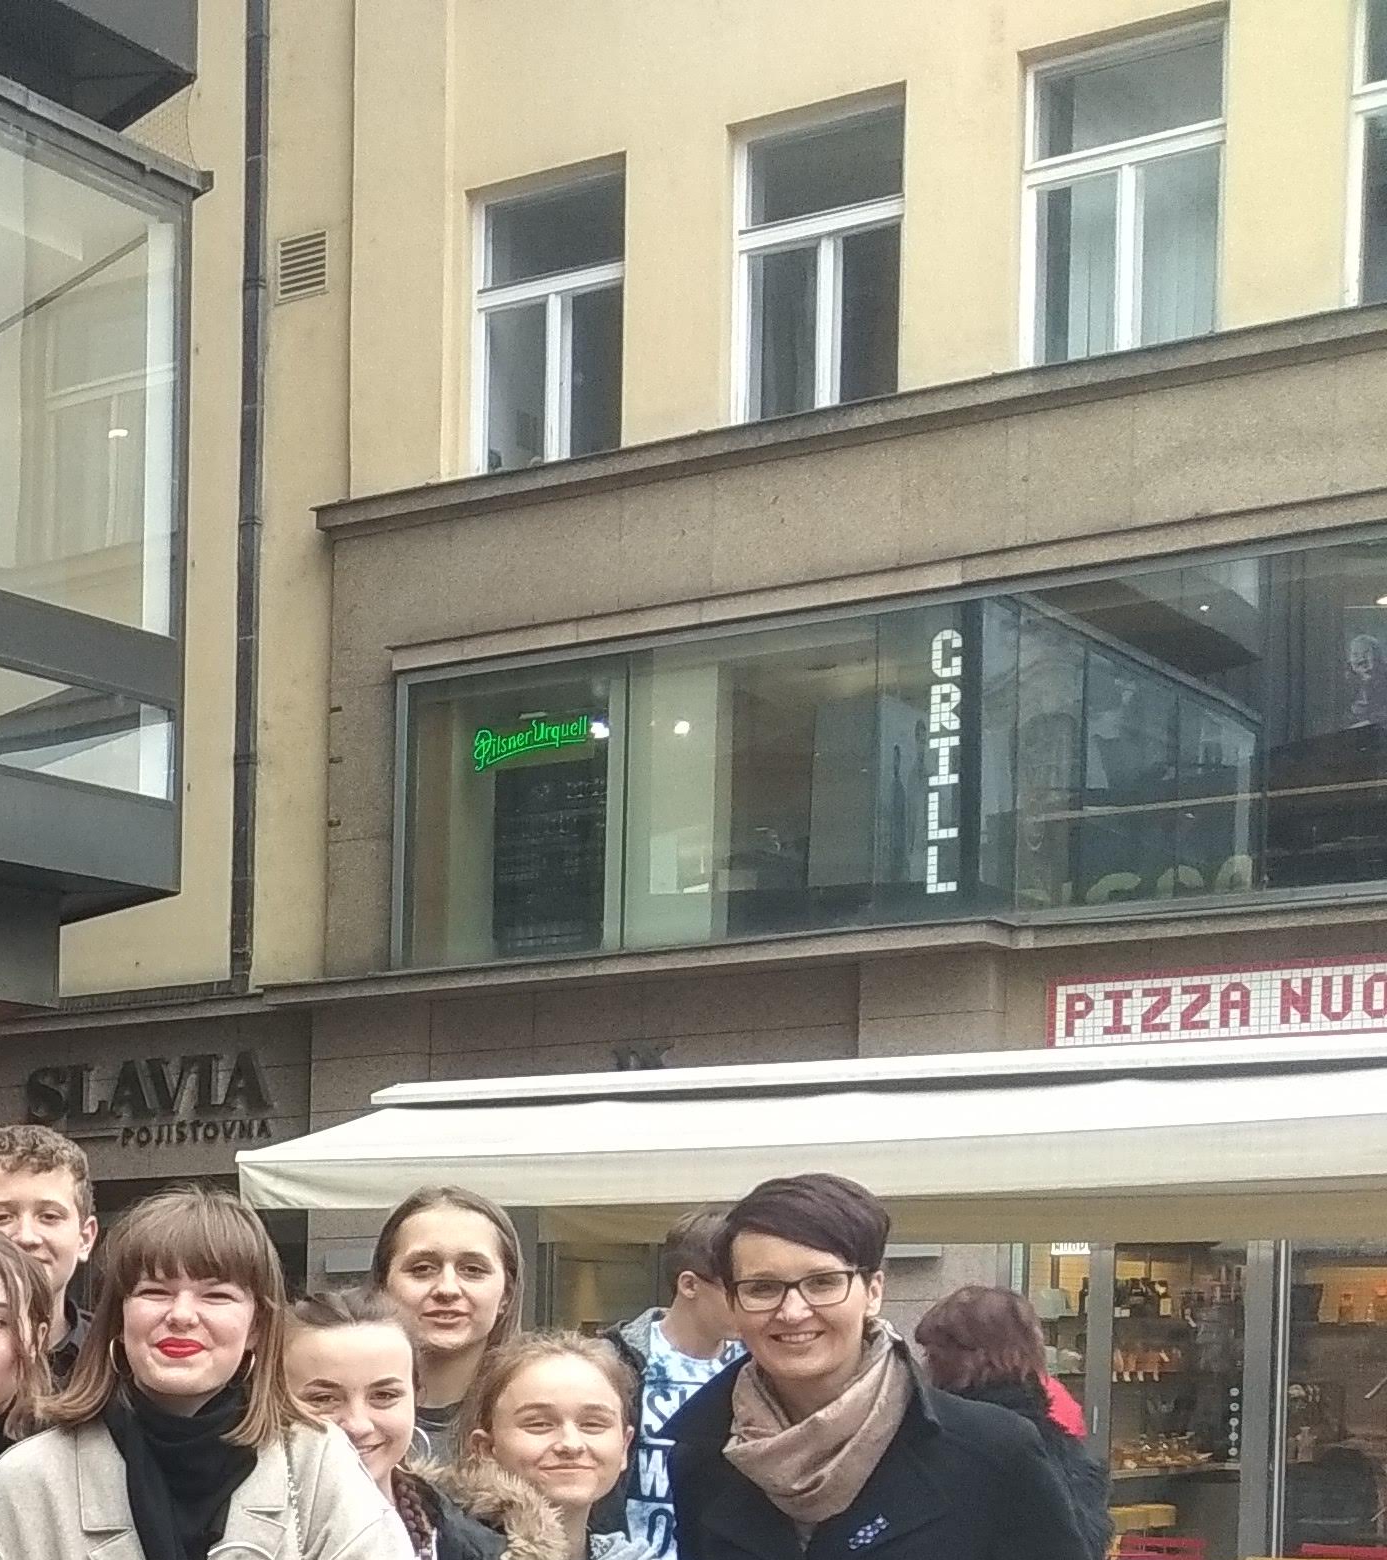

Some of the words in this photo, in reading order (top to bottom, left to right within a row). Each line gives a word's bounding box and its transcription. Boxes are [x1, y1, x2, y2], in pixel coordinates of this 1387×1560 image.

[474, 720, 532, 772] Pilsner
[531, 705, 588, 748] Urquell
[1065, 981, 1251, 1038] PIZZA
[27, 1051, 274, 1121] SLAVIA
